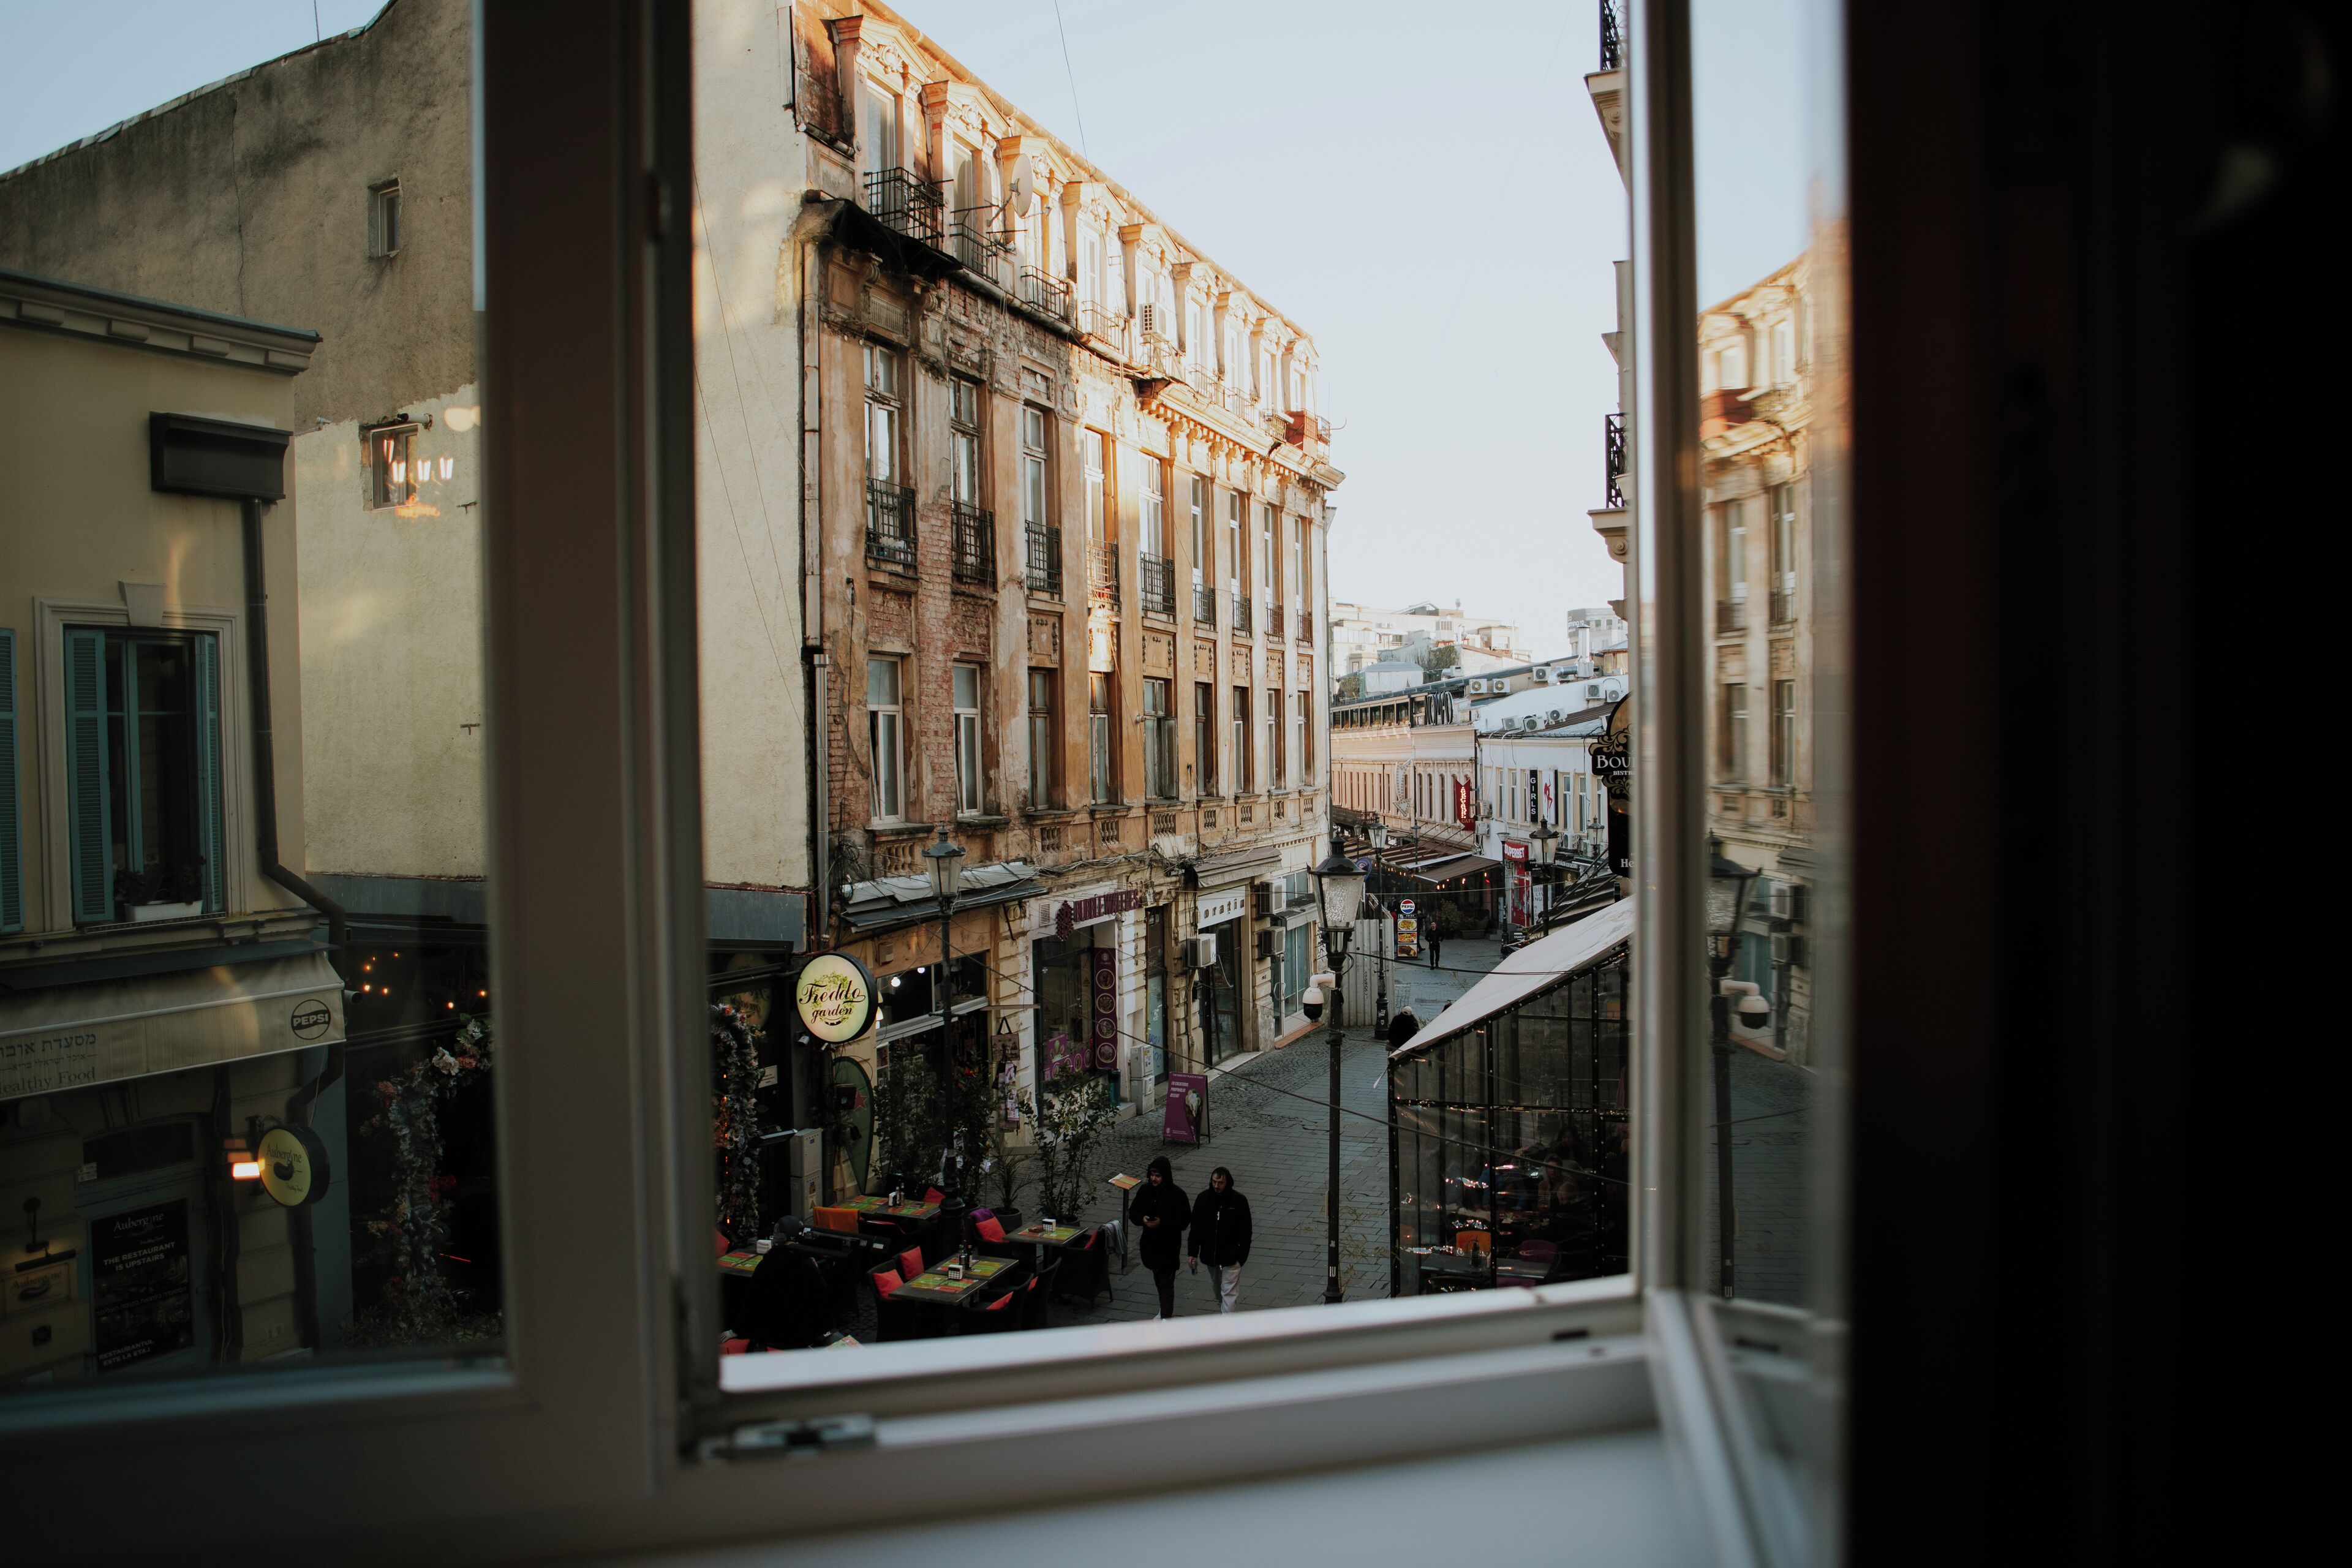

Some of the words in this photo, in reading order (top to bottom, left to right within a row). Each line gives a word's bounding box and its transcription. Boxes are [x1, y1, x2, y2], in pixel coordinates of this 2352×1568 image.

[1504, 844, 1525, 859] SUPERBET
[1074, 897, 1104, 922] BUBBLE
[1104, 889, 1139, 916] WAFFLES
[799, 980, 865, 1005] Freddo
[293, 1013, 329, 1027] PEPSI
[811, 1004, 853, 1023] garden
[41, 1033, 96, 1052] מסעדת
[58, 1066, 95, 1084] Food
[266, 1144, 301, 1164] Aubergine
[103, 1256, 121, 1266] THE
[122, 1241, 176, 1261] RESTAURANT
[115, 1264, 124, 1272] IS
[125, 1253, 165, 1270] UPSTAIRS
[98, 1339, 154, 1360] RESTAURANTUL
[103, 1356, 121, 1366] ESTE
[131, 1347, 151, 1357] ETAJ
